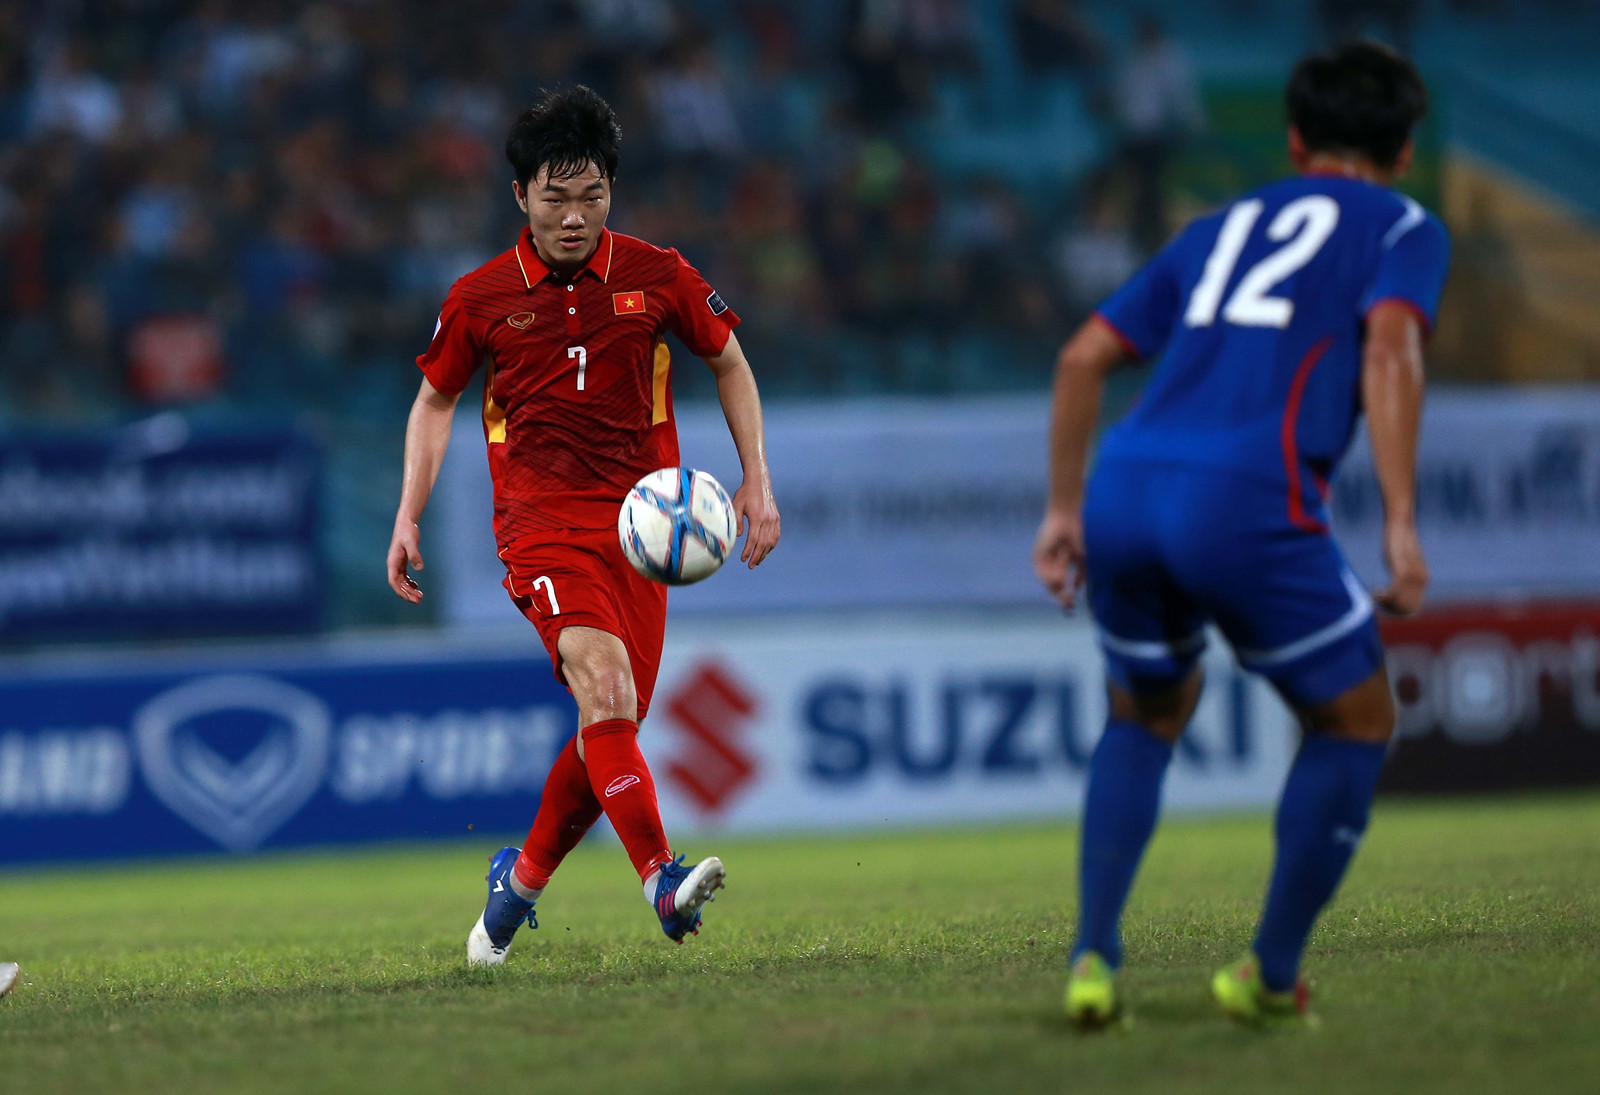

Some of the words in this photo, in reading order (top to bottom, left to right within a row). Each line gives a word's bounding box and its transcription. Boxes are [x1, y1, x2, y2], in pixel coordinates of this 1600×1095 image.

[1184, 194, 1340, 329] 12
[567, 345, 588, 391] 7
[532, 575, 561, 615] 7
[338, 712, 563, 800] SPORT
